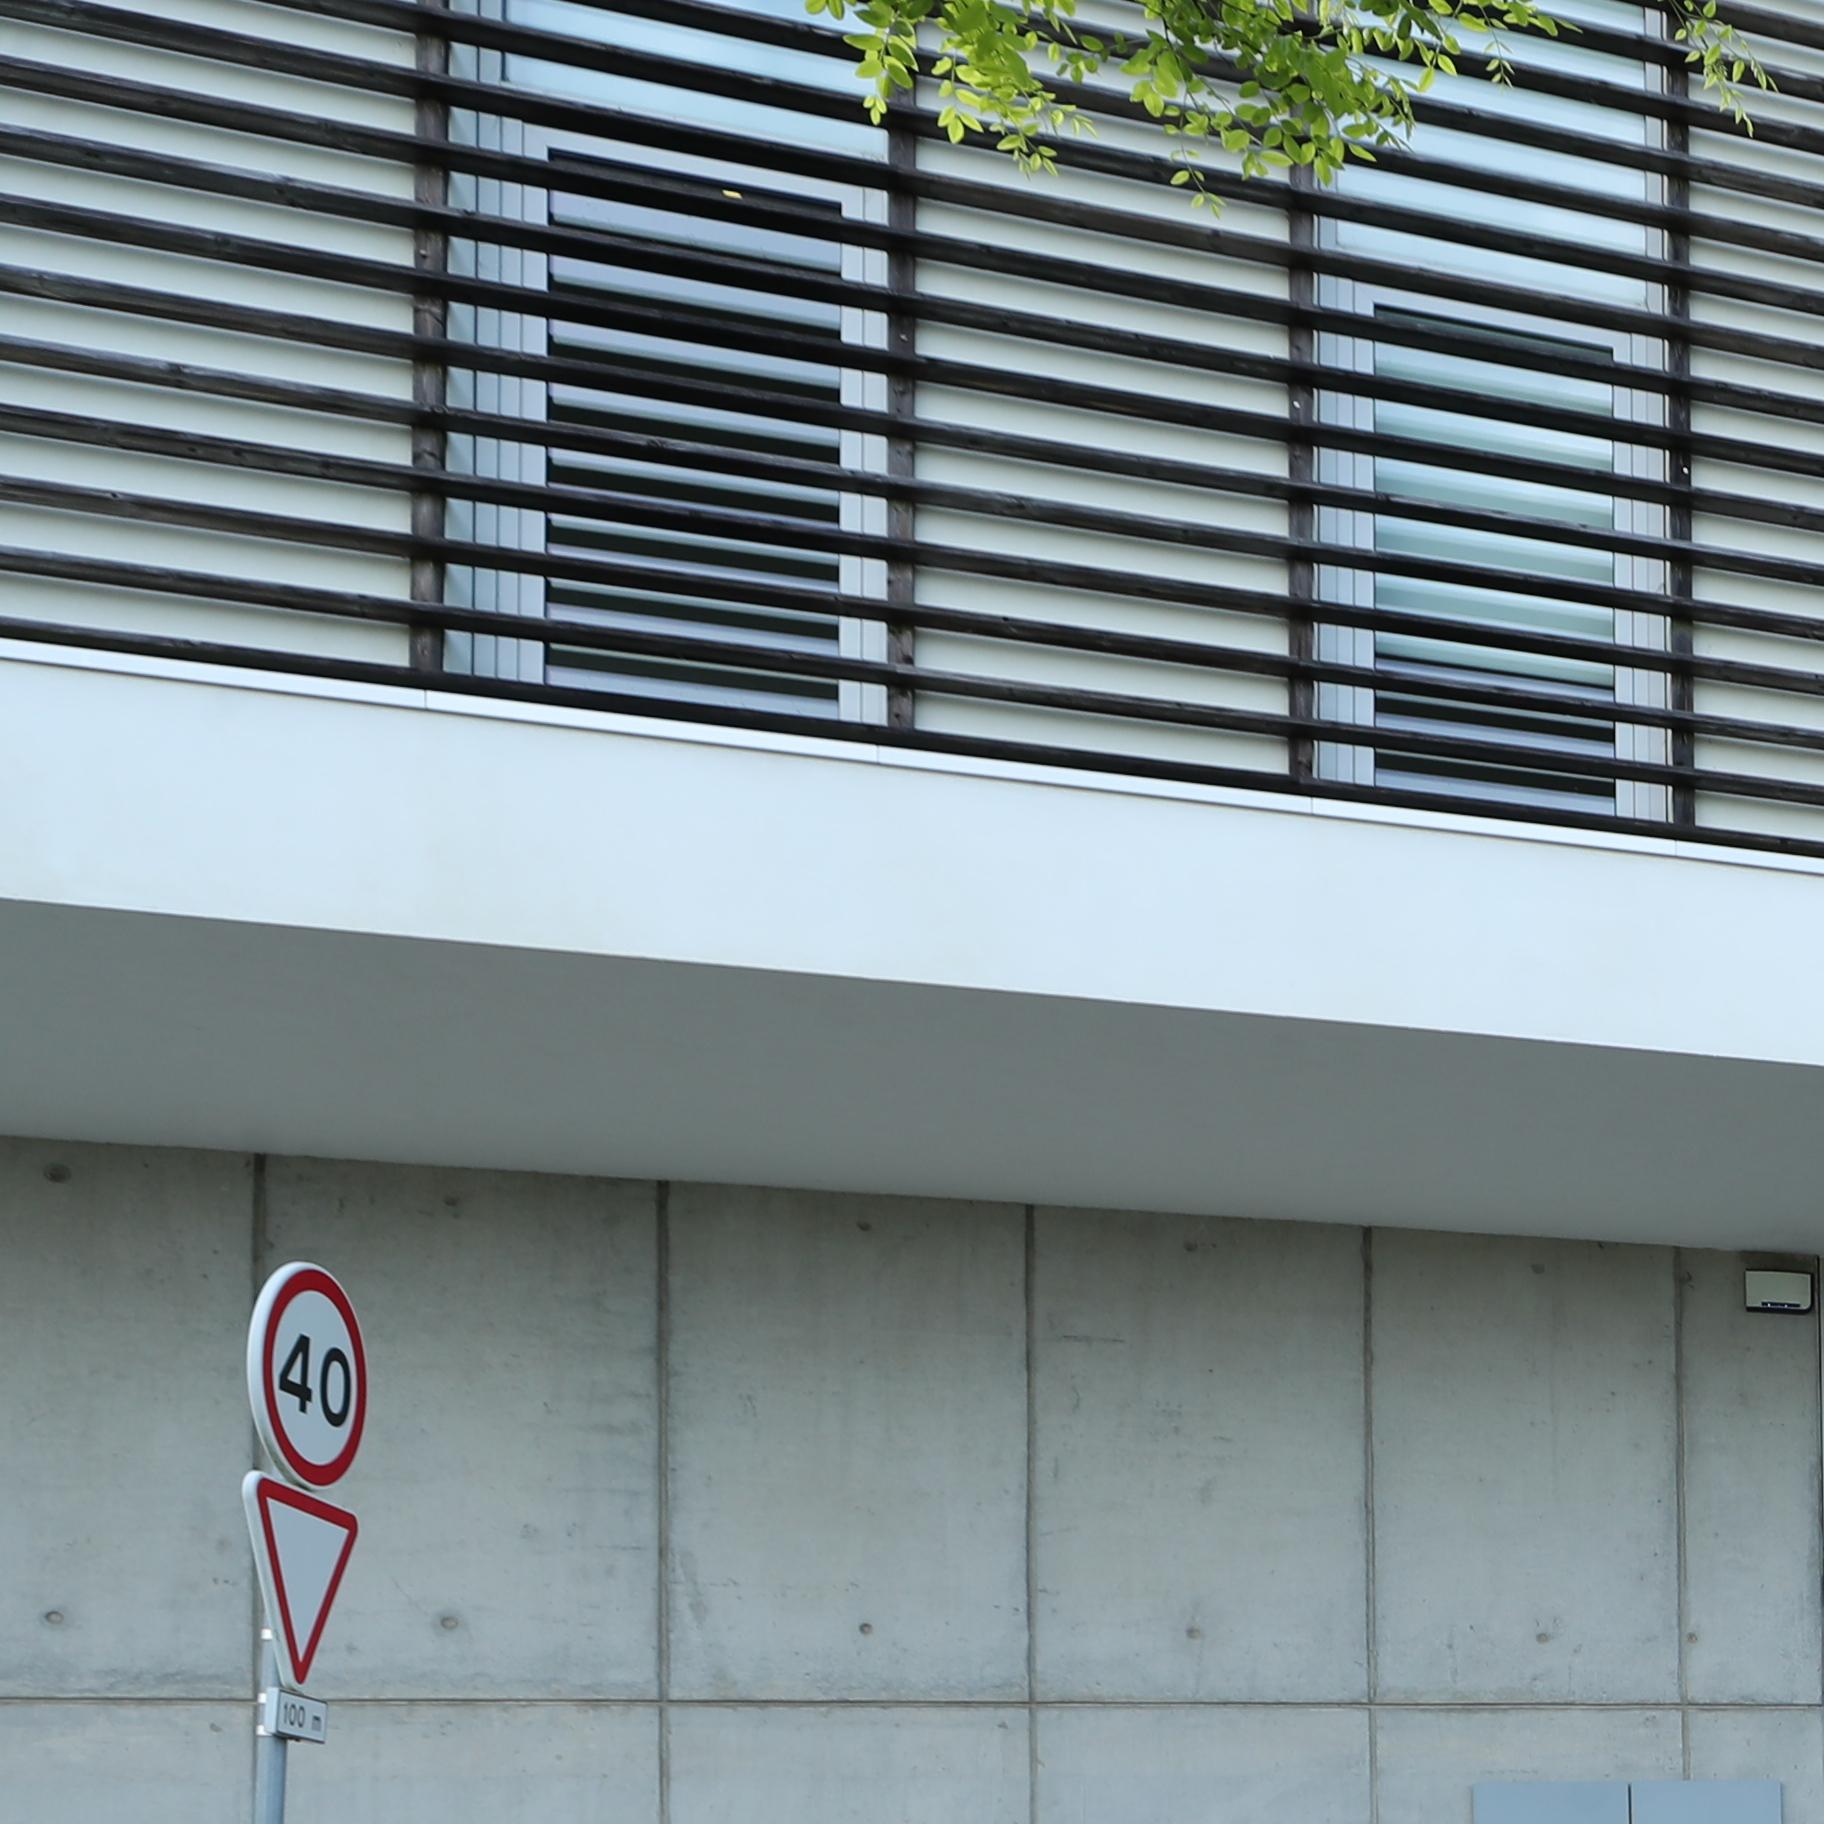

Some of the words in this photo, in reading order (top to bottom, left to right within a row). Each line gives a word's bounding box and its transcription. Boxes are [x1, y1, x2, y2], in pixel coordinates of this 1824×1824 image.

[279, 1334, 351, 1427] 40
[283, 1701, 305, 1728] 100
[312, 1715, 321, 1732] m
